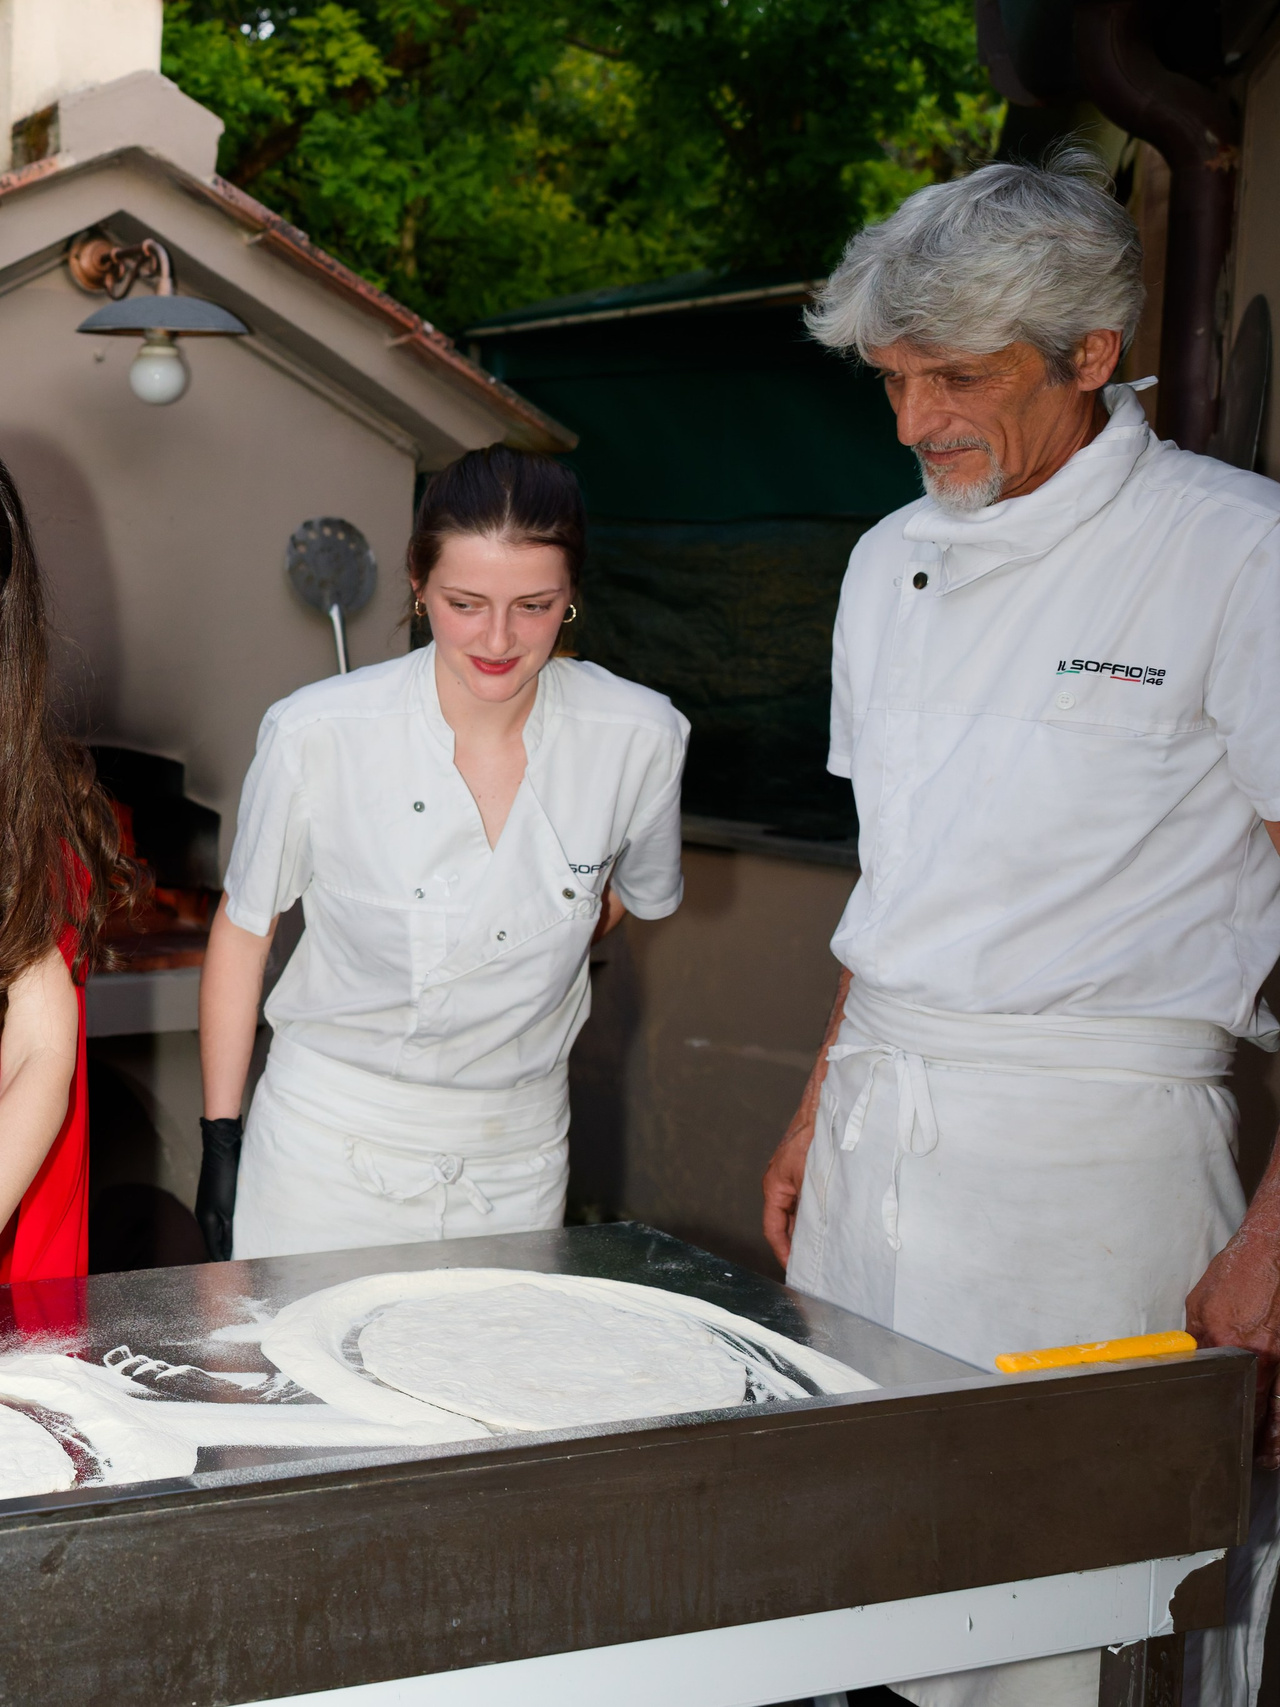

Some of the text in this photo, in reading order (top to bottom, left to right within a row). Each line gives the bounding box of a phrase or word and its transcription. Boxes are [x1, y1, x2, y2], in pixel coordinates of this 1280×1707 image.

[1070, 659, 1143, 678] SOFFIO
[1148, 667, 1166, 677] 58
[1146, 677, 1163, 686] 46
